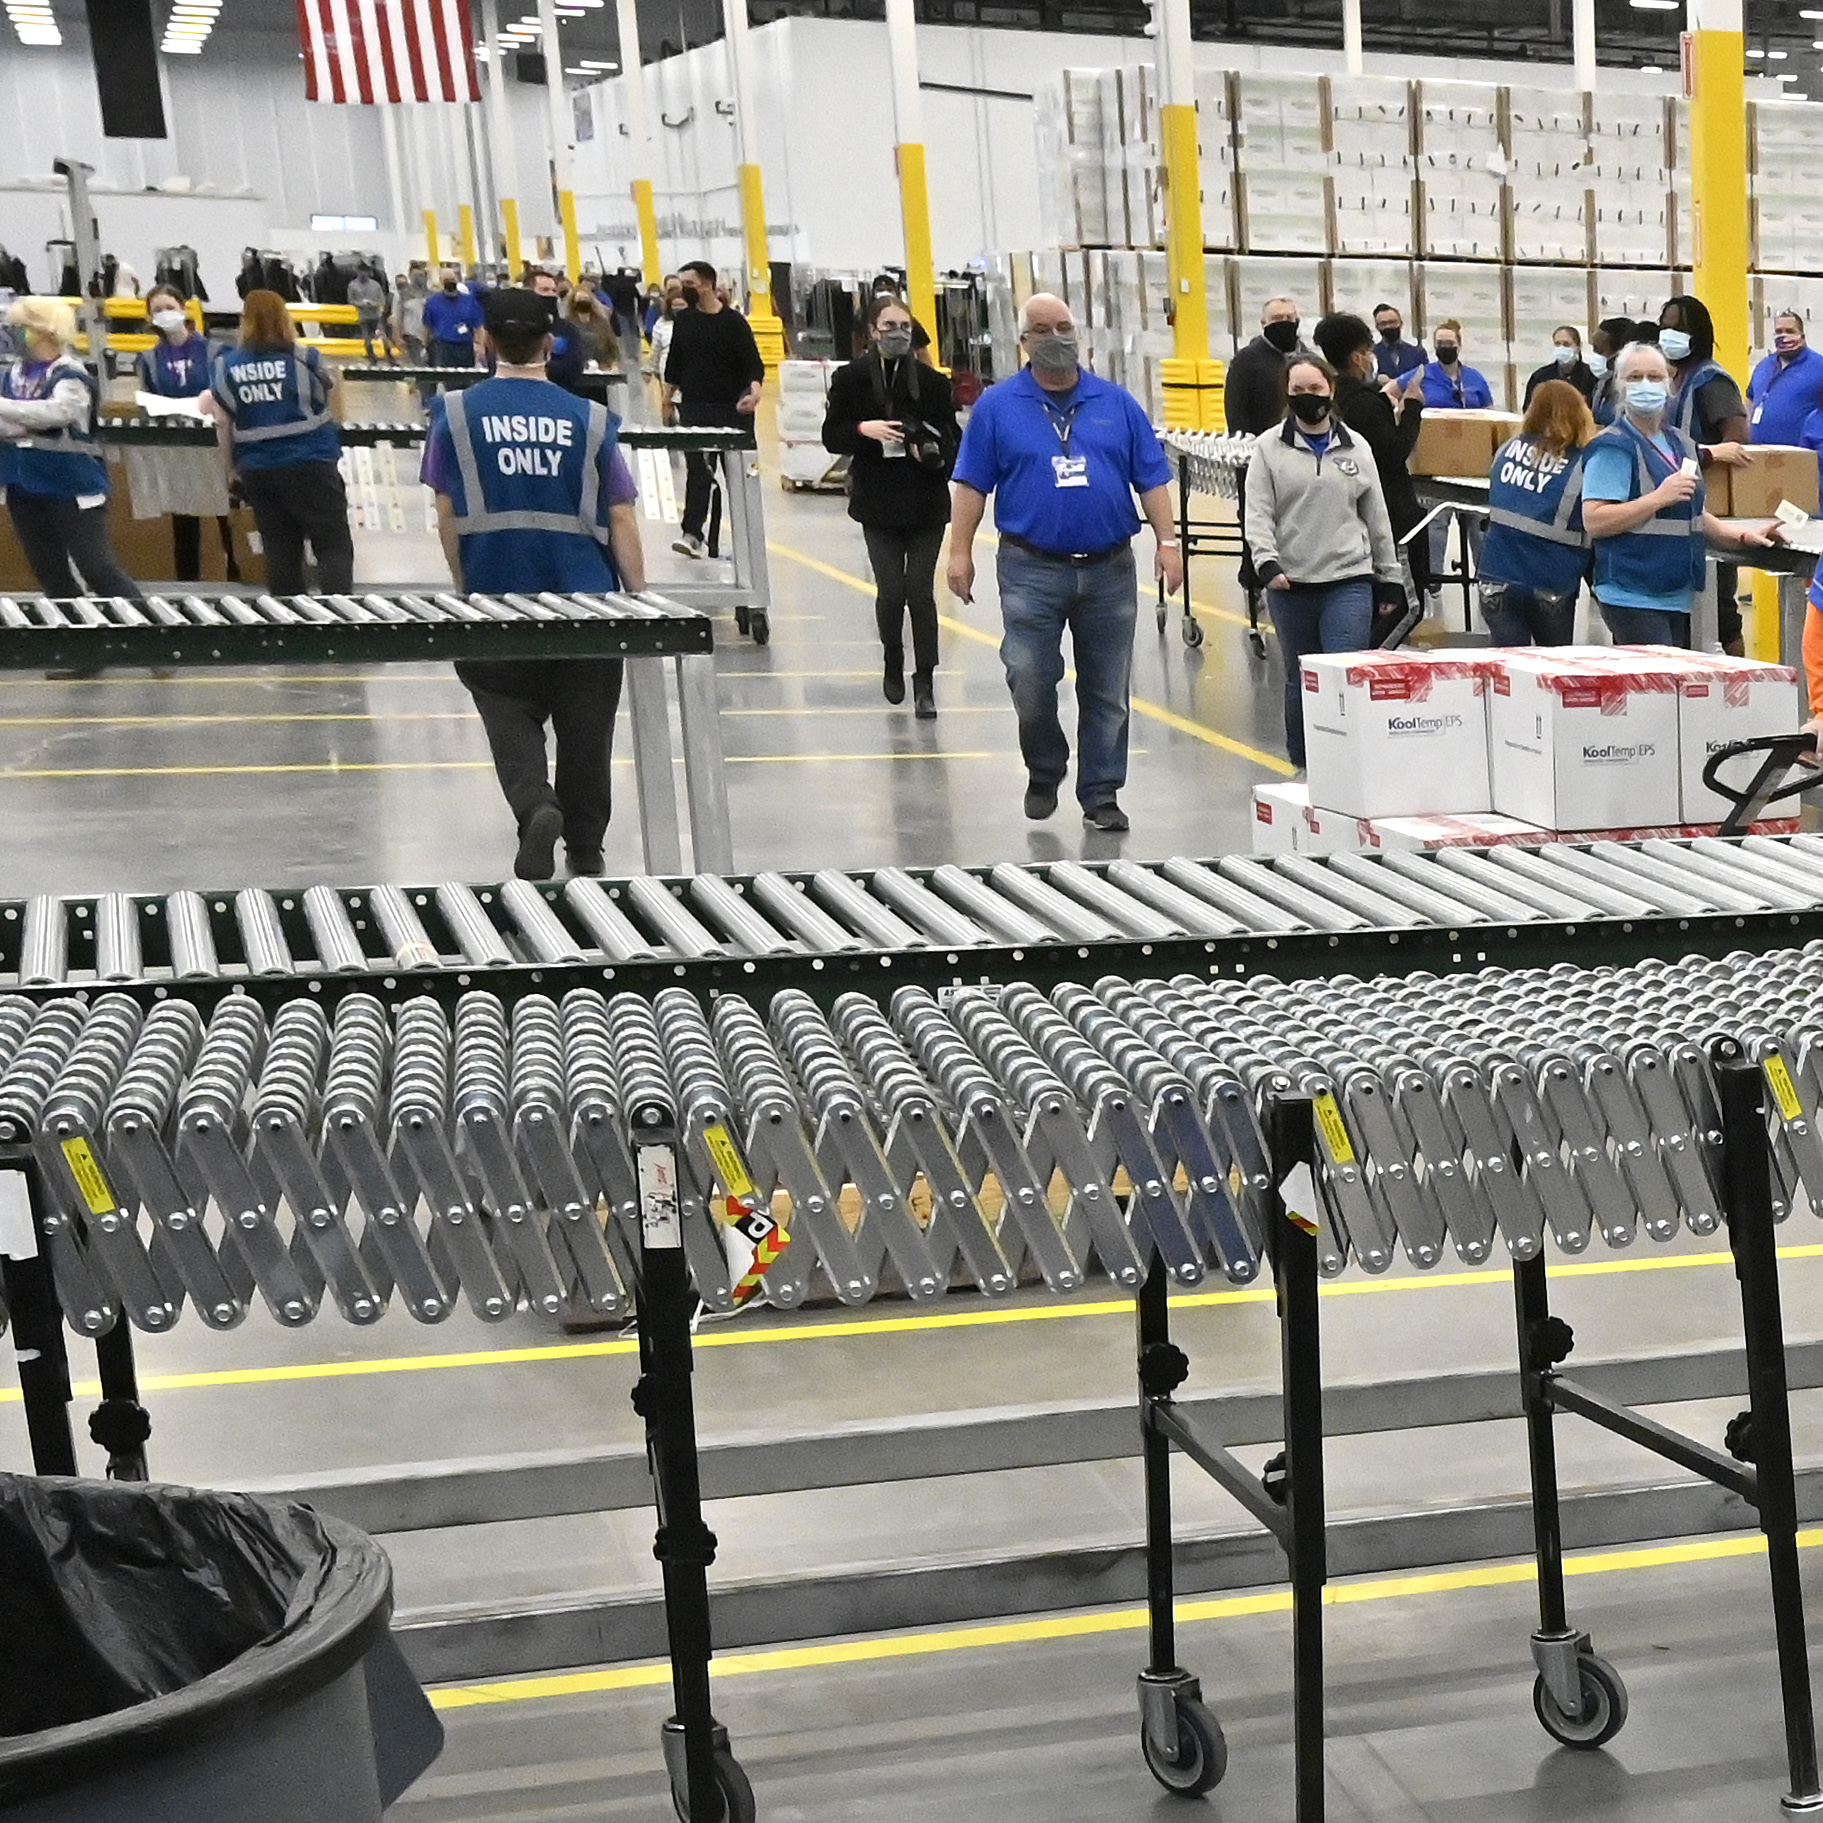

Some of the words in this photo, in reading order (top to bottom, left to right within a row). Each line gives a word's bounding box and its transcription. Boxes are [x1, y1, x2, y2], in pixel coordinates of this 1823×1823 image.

[238, 382, 283, 404] ONLY
[482, 415, 573, 447] INSIDE
[498, 447, 563, 476] ONLY
[1500, 461, 1552, 493] ONLY
[1388, 717, 1443, 730] KoolTemp
[1445, 714, 1463, 728] EPS
[1639, 743, 1655, 756] EPS
